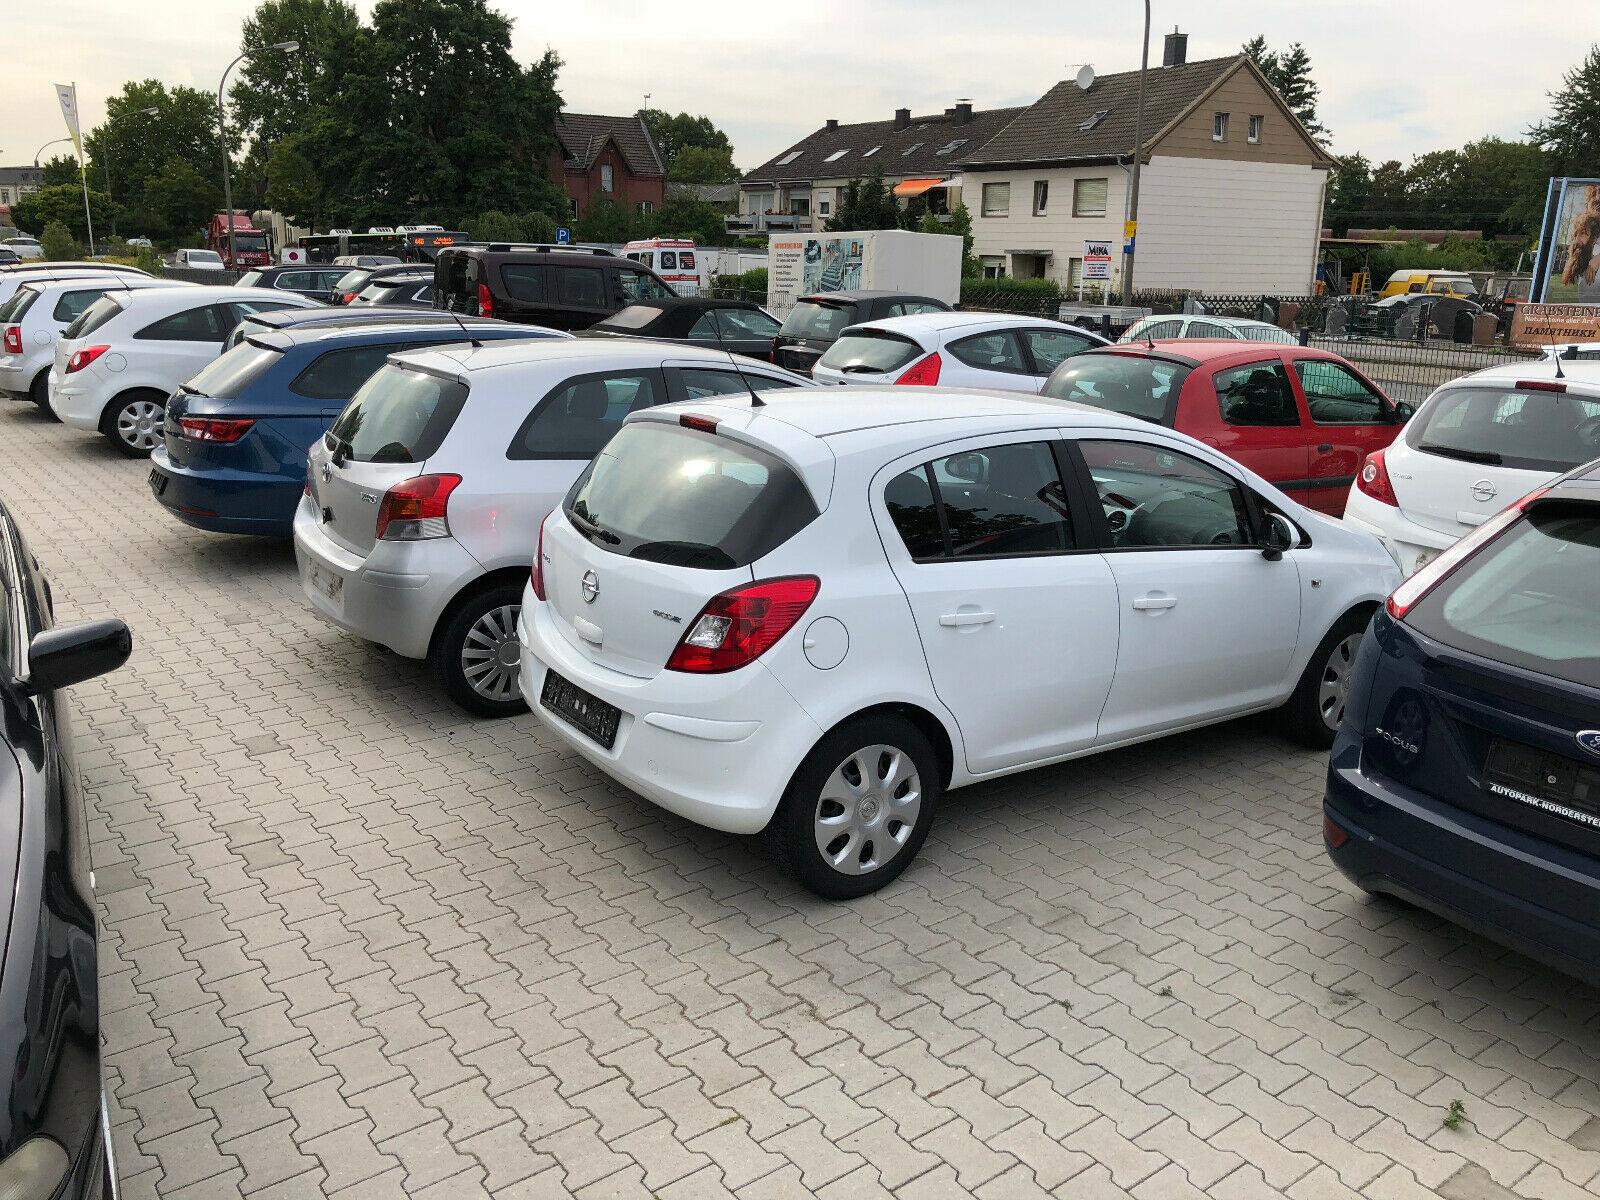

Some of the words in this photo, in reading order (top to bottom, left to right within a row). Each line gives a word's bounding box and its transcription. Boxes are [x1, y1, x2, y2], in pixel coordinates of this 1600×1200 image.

[559, 229, 567, 240] P
[1375, 726, 1420, 755] FOCUS
[1490, 782, 1600, 830] AUTOPARK-NORDERSTE
